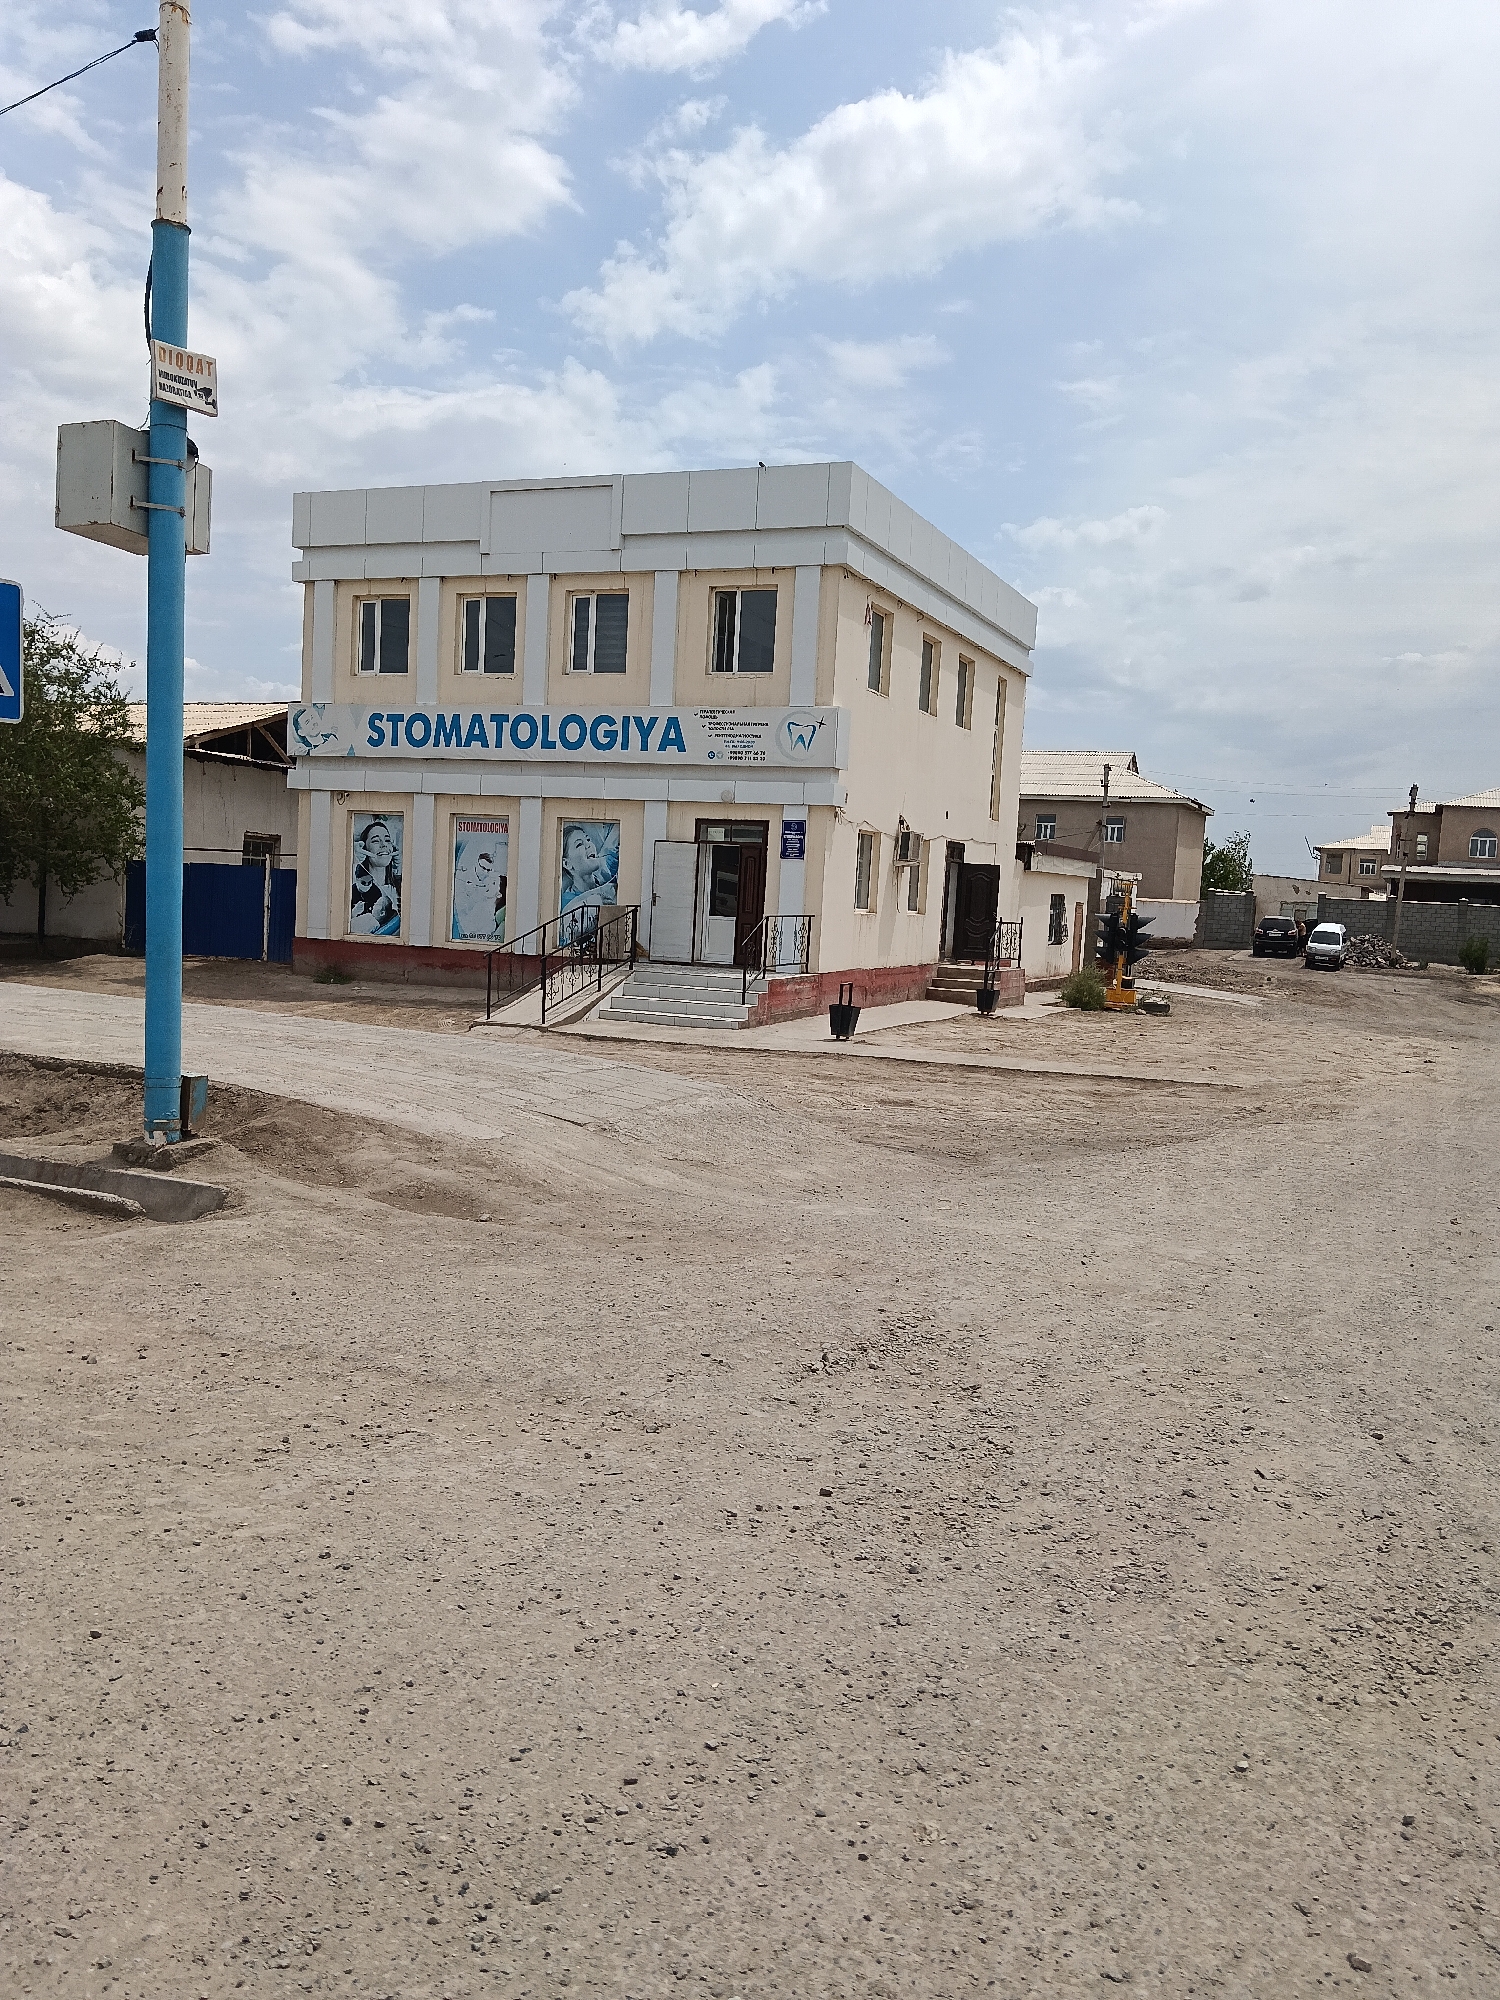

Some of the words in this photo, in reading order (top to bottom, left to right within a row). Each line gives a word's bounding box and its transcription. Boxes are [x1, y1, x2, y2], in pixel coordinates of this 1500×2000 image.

[158, 345, 214, 377] DIQQAT
[366, 712, 687, 752] STOMATOLOGIYA
[458, 821, 509, 834] STOMATOLOGIYA
